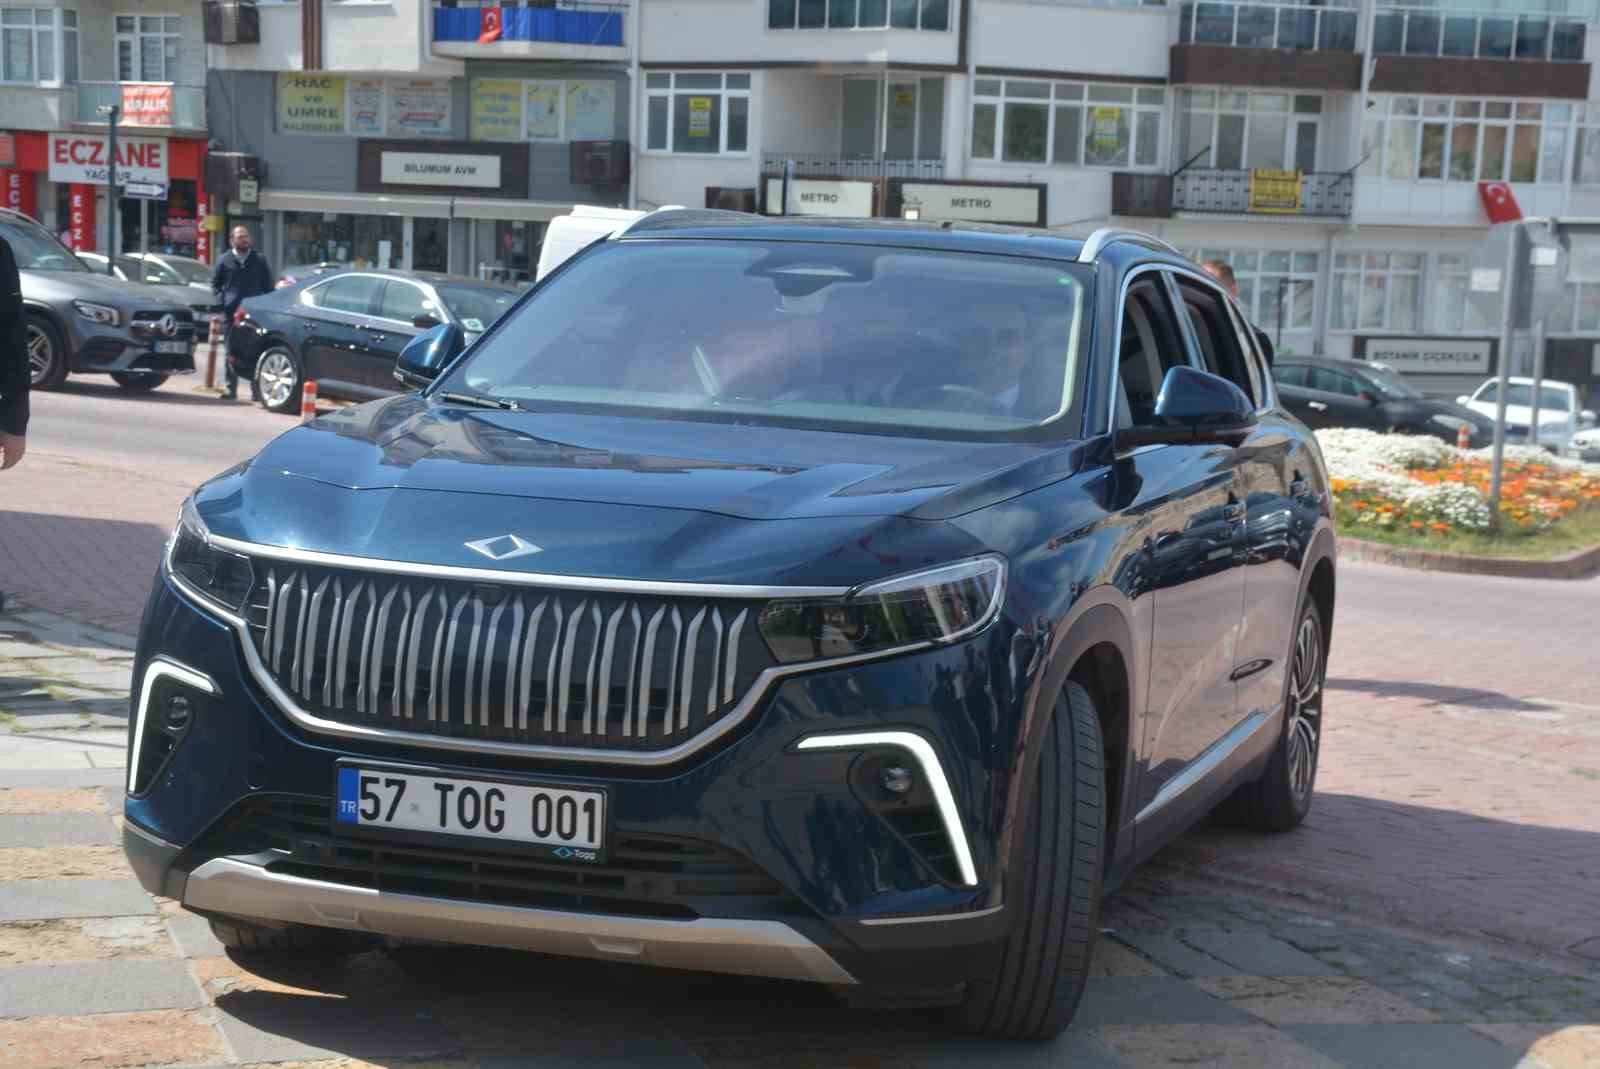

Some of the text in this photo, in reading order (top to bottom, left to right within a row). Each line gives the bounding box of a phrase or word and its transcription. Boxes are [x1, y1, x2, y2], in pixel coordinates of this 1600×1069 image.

[294, 78, 333, 89] HAC
[287, 107, 340, 119] UMRE
[54, 139, 161, 168] ECZANE
[800, 192, 838, 204] METRO
[951, 198, 992, 209] METRO
[340, 776, 597, 844] TR 57 TOG 001
